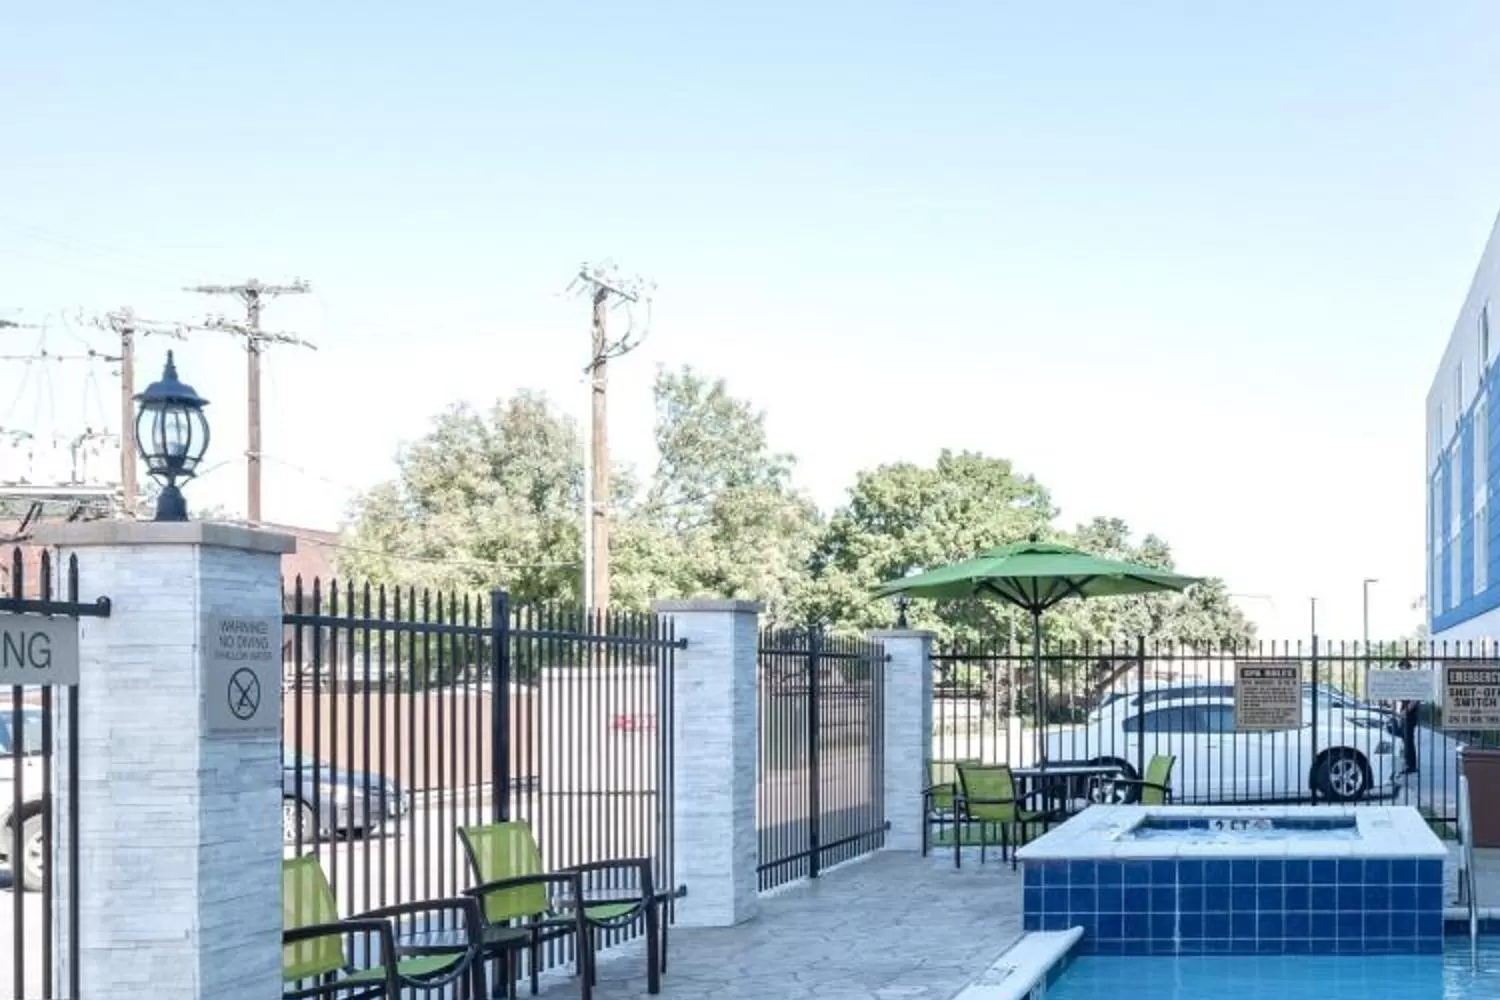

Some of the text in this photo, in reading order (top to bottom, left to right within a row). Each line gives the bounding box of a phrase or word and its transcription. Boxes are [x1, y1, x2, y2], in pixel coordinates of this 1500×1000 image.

[219, 635, 269, 649] NO DIVING
[1453, 697, 1497, 708] SWITCH
